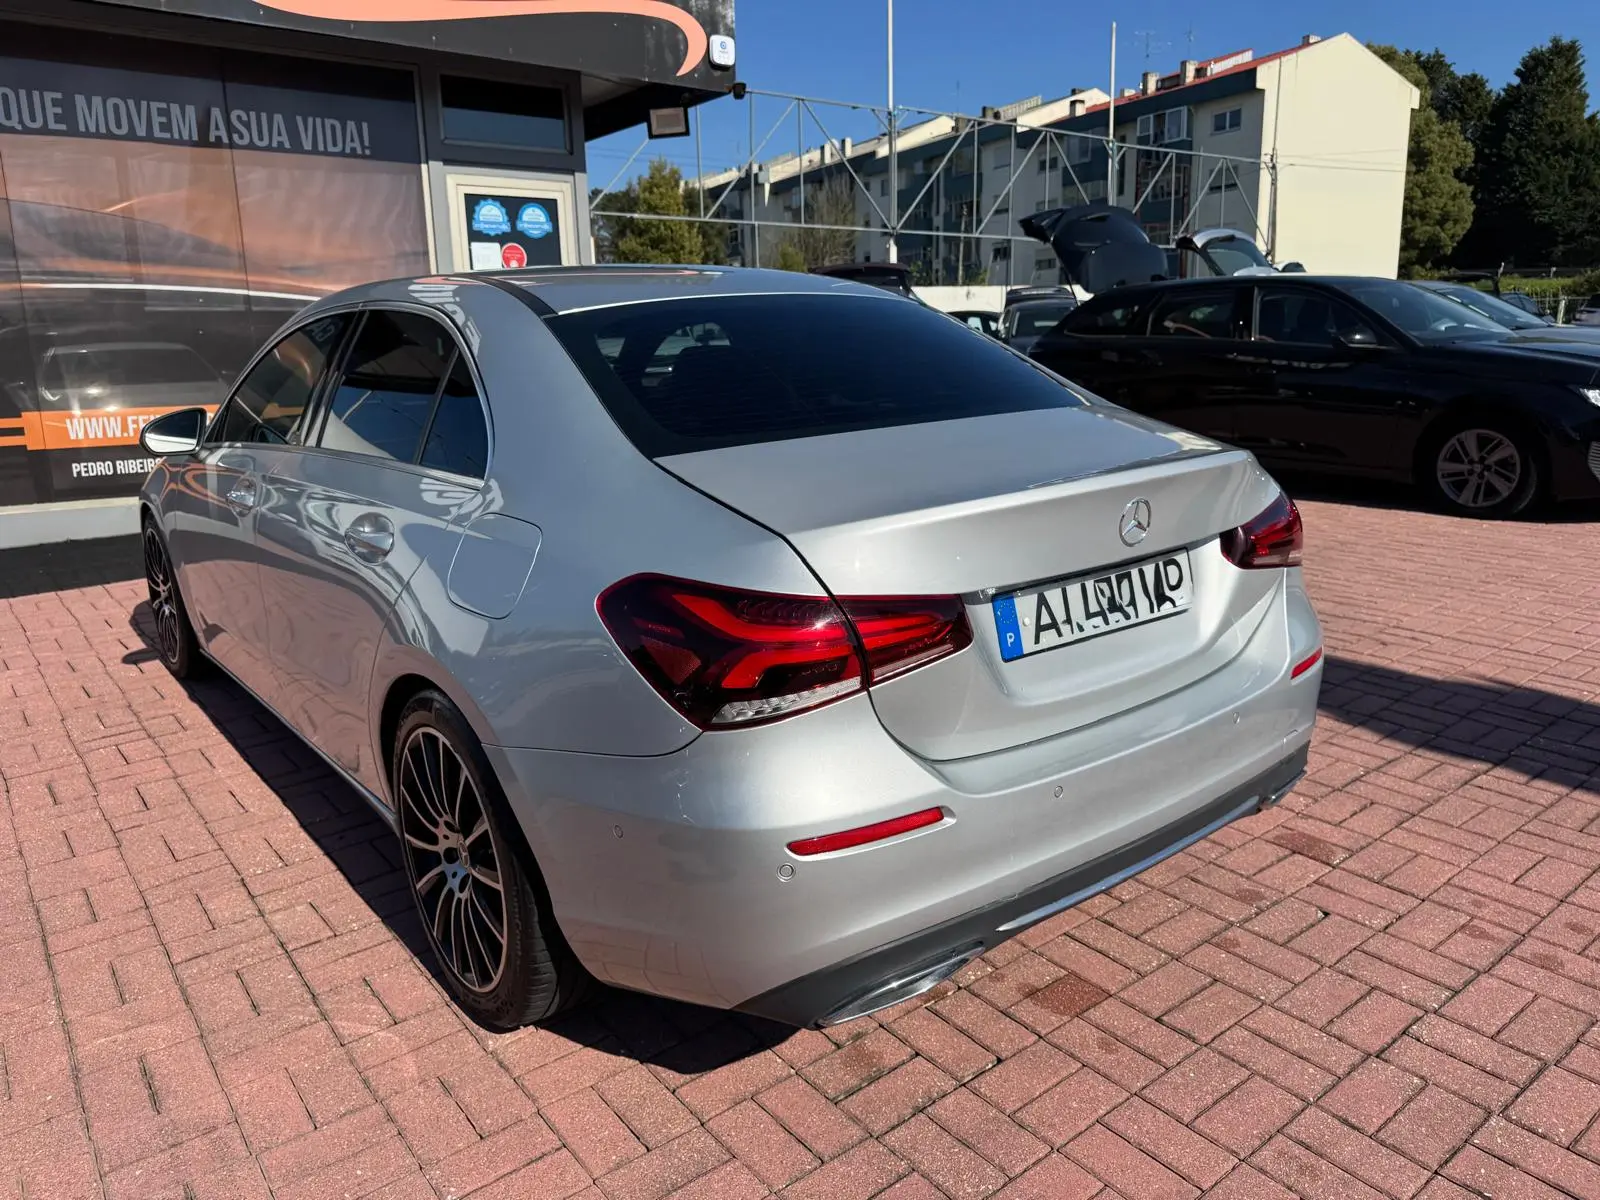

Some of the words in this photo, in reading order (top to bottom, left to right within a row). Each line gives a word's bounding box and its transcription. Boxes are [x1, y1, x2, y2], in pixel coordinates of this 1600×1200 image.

[0, 86, 67, 130] QUE
[74, 94, 200, 142] MOVEM
[296, 115, 372, 155] VIDA!
[71, 461, 114, 478] PEDRO
[1006, 632, 1015, 648] P
